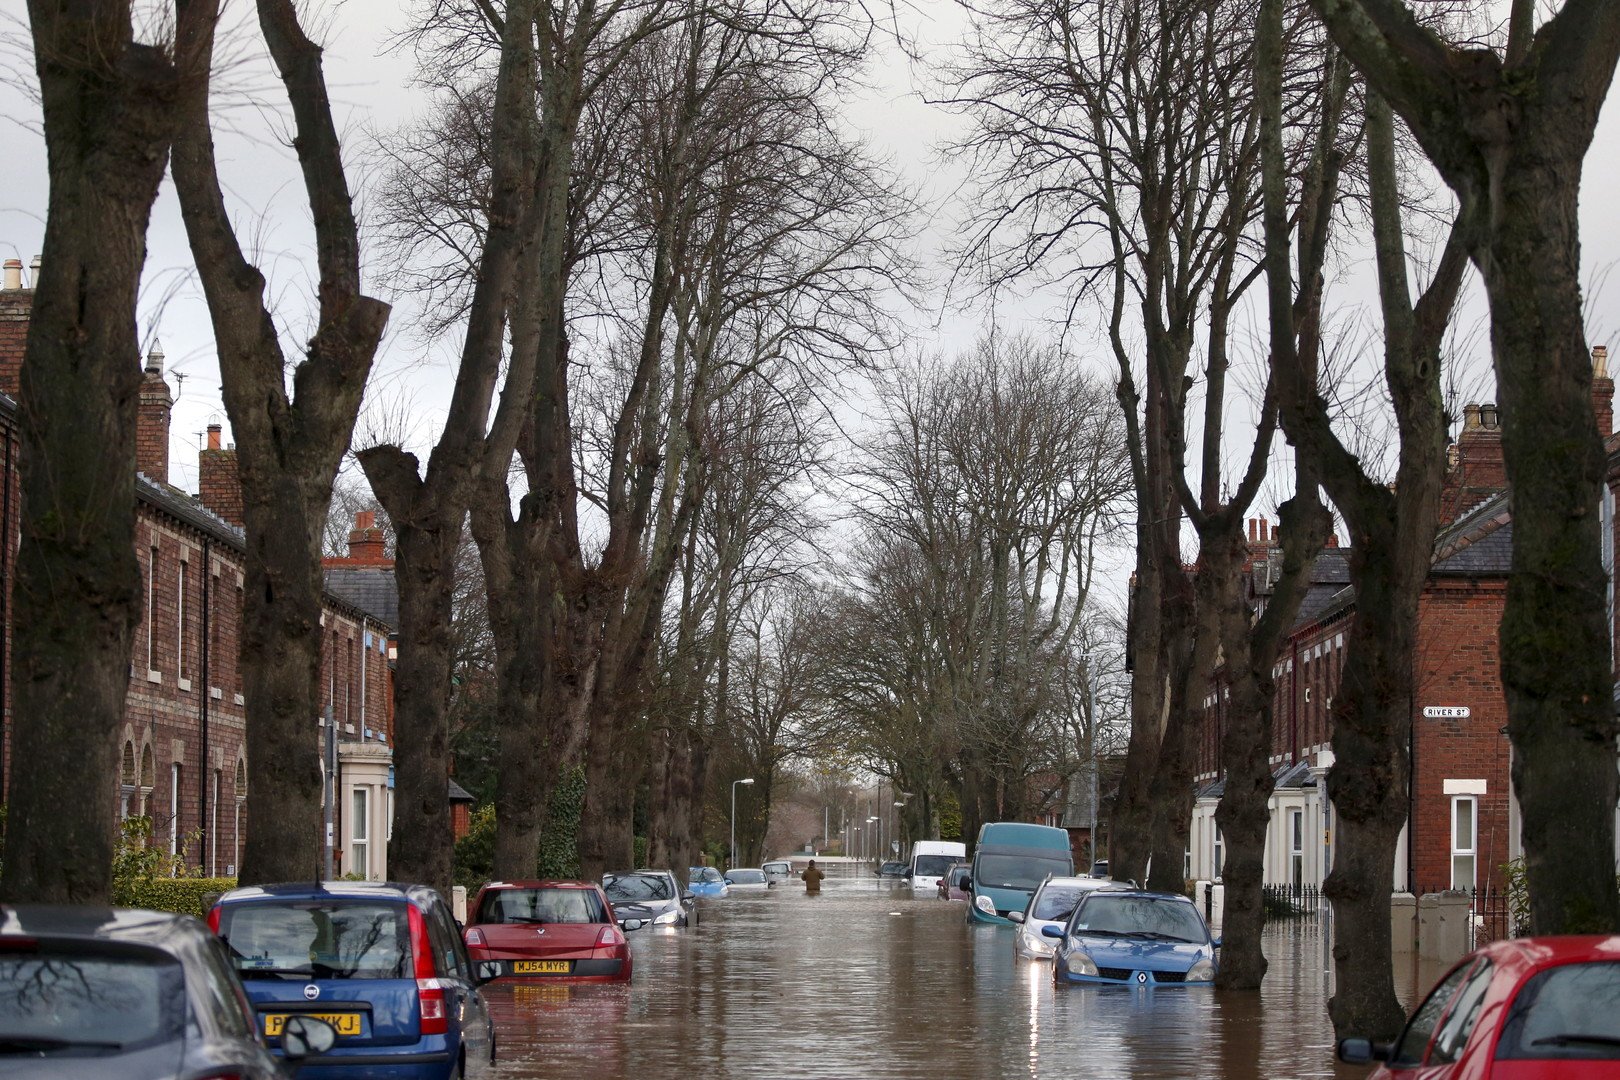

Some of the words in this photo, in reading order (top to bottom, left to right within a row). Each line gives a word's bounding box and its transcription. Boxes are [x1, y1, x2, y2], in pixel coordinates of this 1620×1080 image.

[1428, 708, 1452, 716] RIVER
[518, 961, 543, 971] MJ54
[547, 961, 565, 971] MYR
